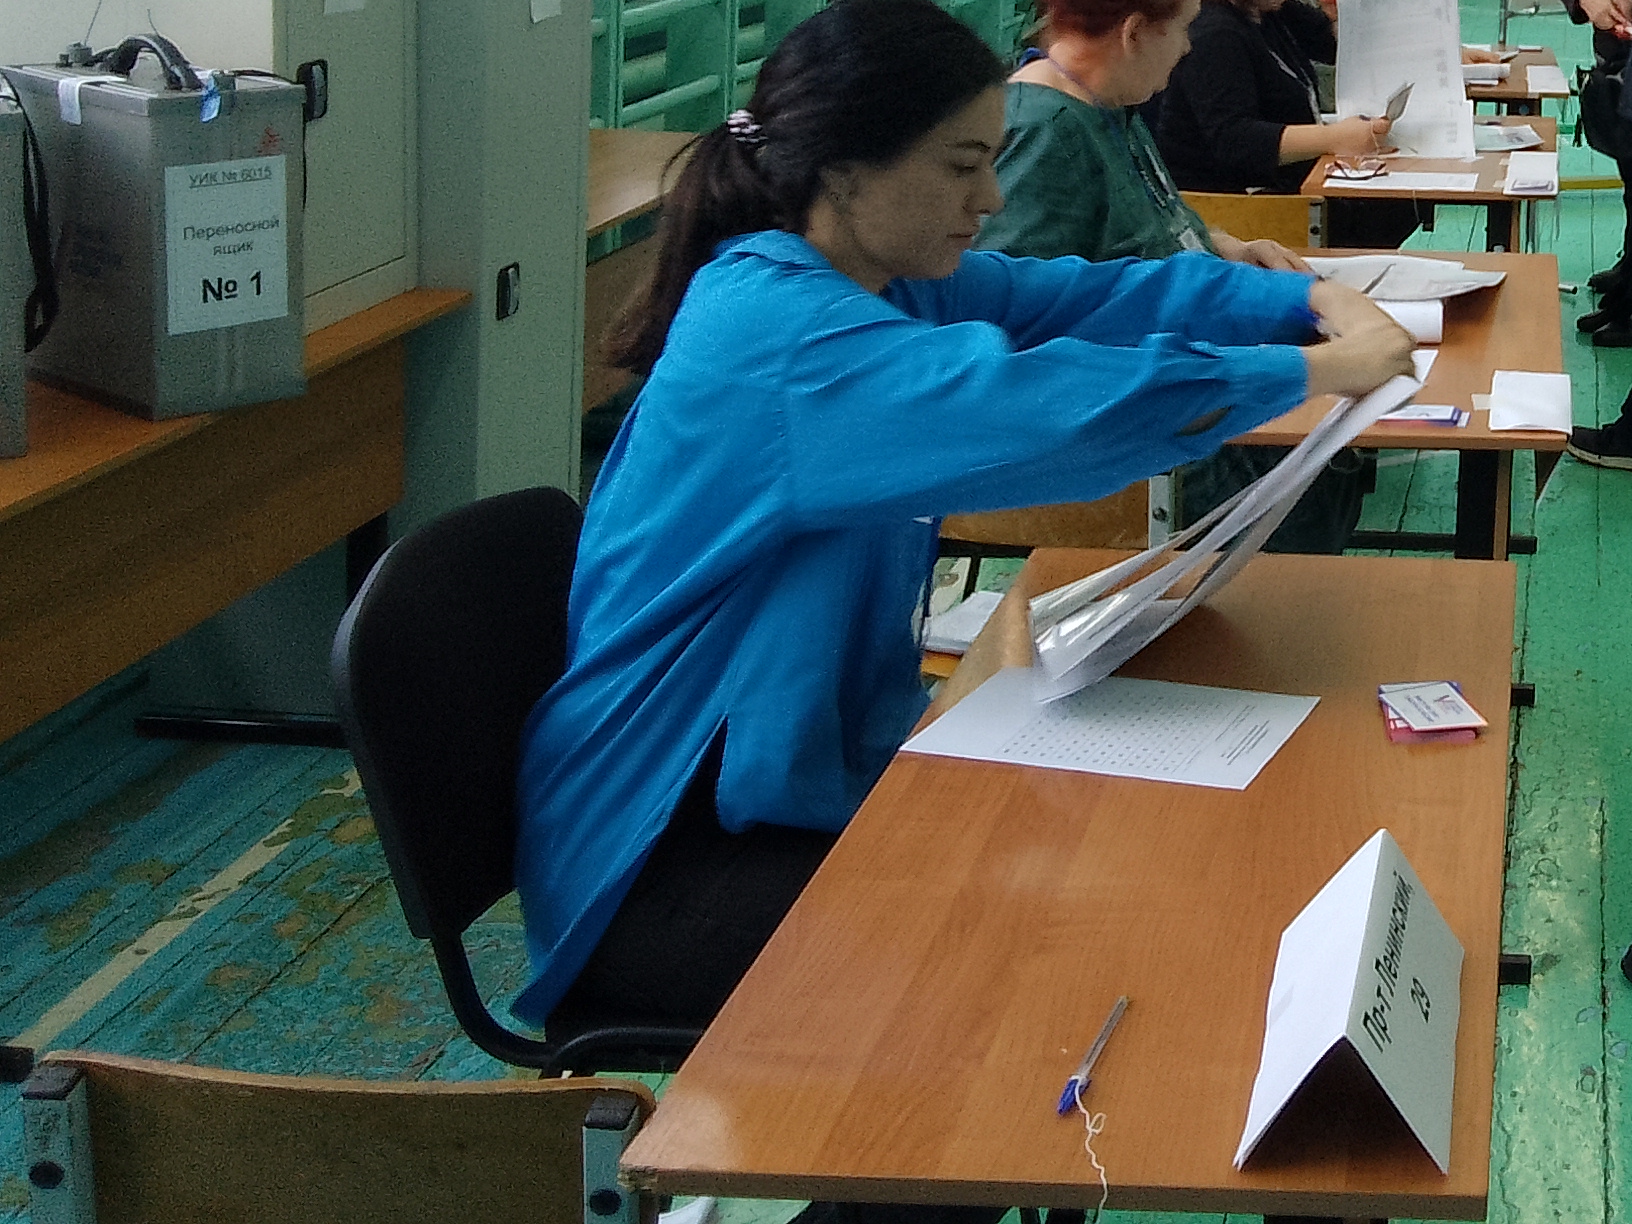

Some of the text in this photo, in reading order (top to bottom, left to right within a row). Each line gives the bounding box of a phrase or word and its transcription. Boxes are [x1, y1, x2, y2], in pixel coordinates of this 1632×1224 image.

[183, 215, 281, 242] Переносной
[213, 241, 254, 256] ящик
[201, 270, 262, 304] № 1
[1362, 870, 1415, 1054] Пр-т Ленинский,
[1410, 976, 1432, 1025] 29
